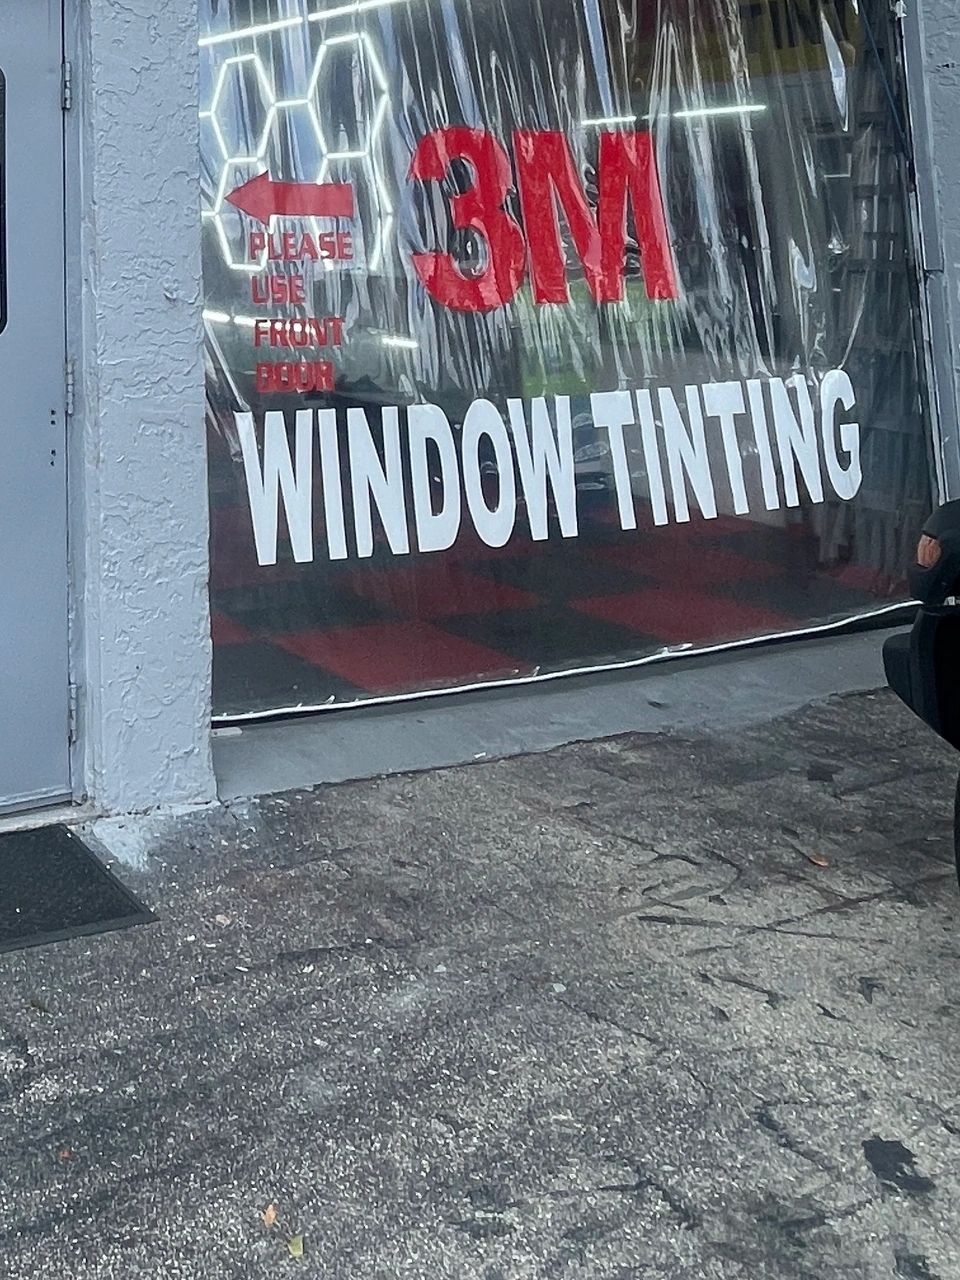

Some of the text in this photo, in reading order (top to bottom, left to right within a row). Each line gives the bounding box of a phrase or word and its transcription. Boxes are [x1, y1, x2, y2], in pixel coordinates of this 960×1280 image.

[409, 123, 677, 312] 3M
[250, 232, 353, 261] PLEASE
[251, 273, 306, 304] USE
[254, 317, 346, 348] FRONT
[256, 361, 336, 392] DOOR
[234, 369, 863, 568] WINDOW TINTING
